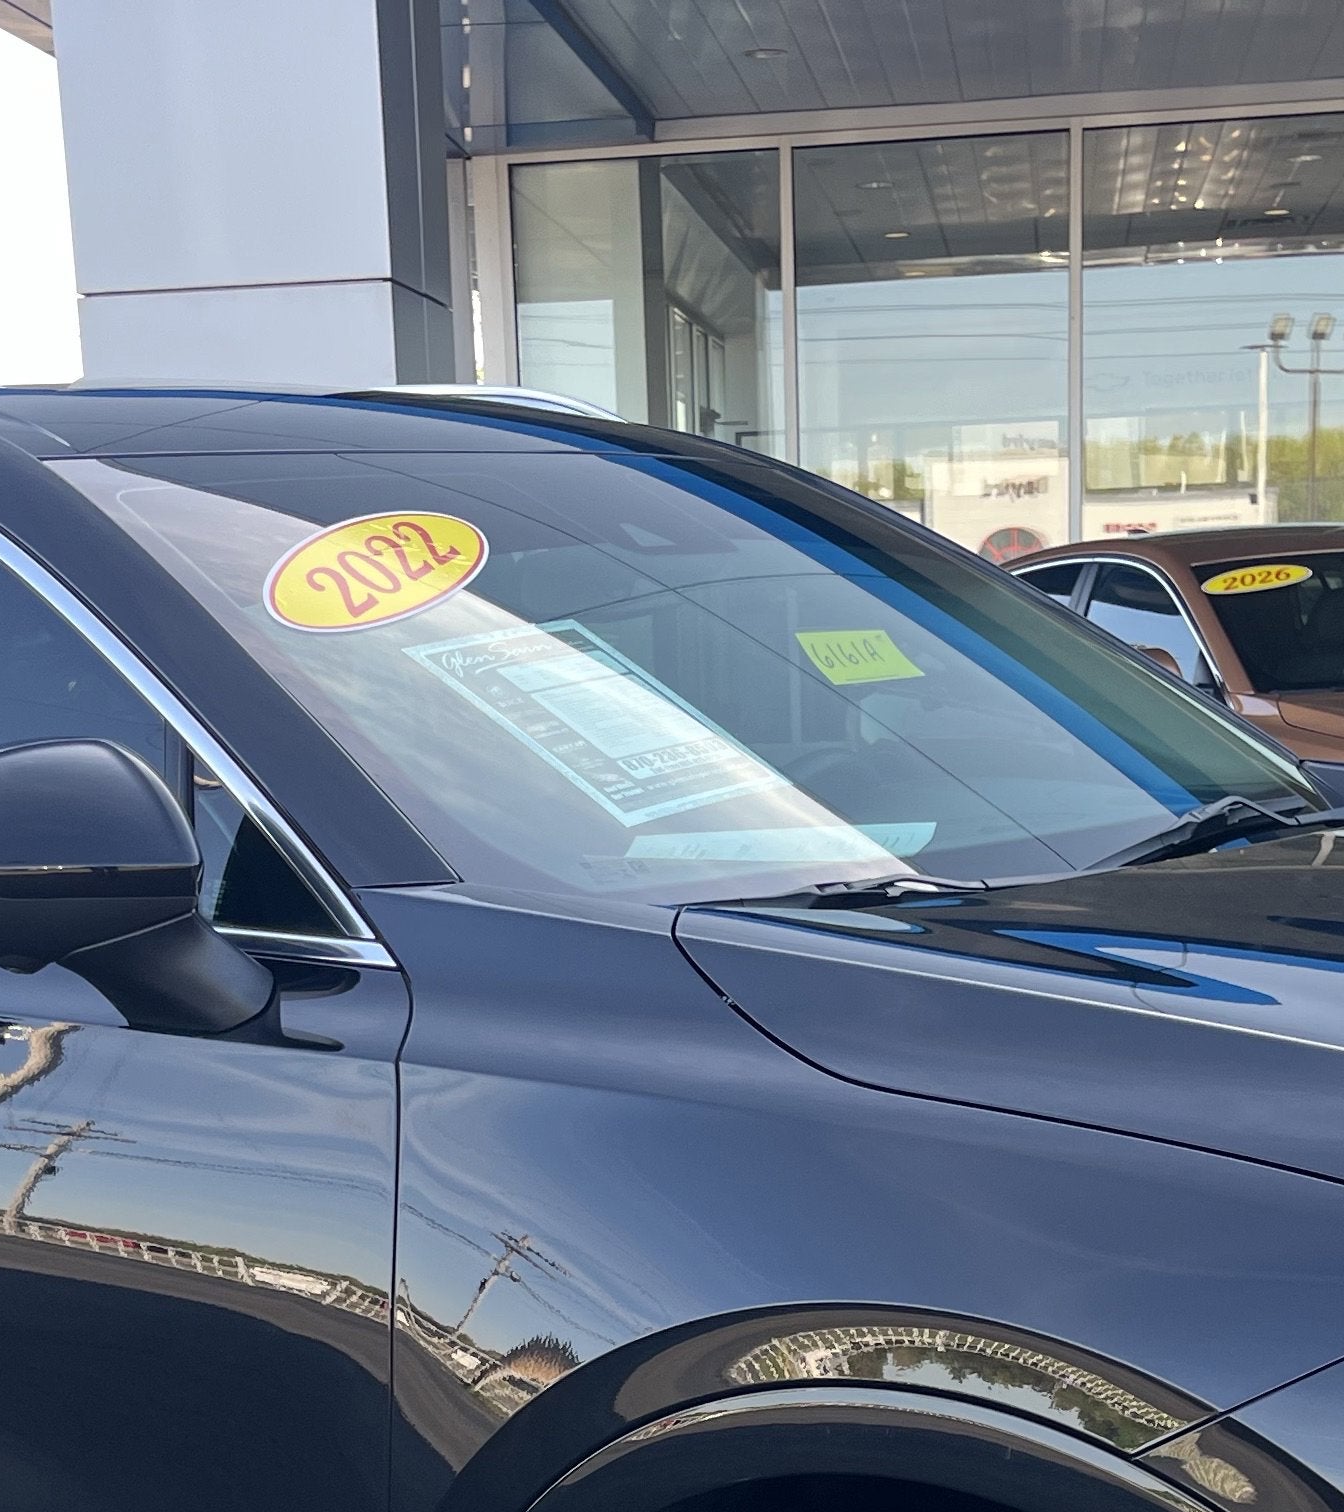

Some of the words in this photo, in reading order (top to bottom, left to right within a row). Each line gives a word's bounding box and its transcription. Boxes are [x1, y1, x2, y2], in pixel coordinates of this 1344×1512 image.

[305, 521, 462, 618] 2022
[1223, 567, 1291, 592] 2026
[441, 650, 495, 678] Glen
